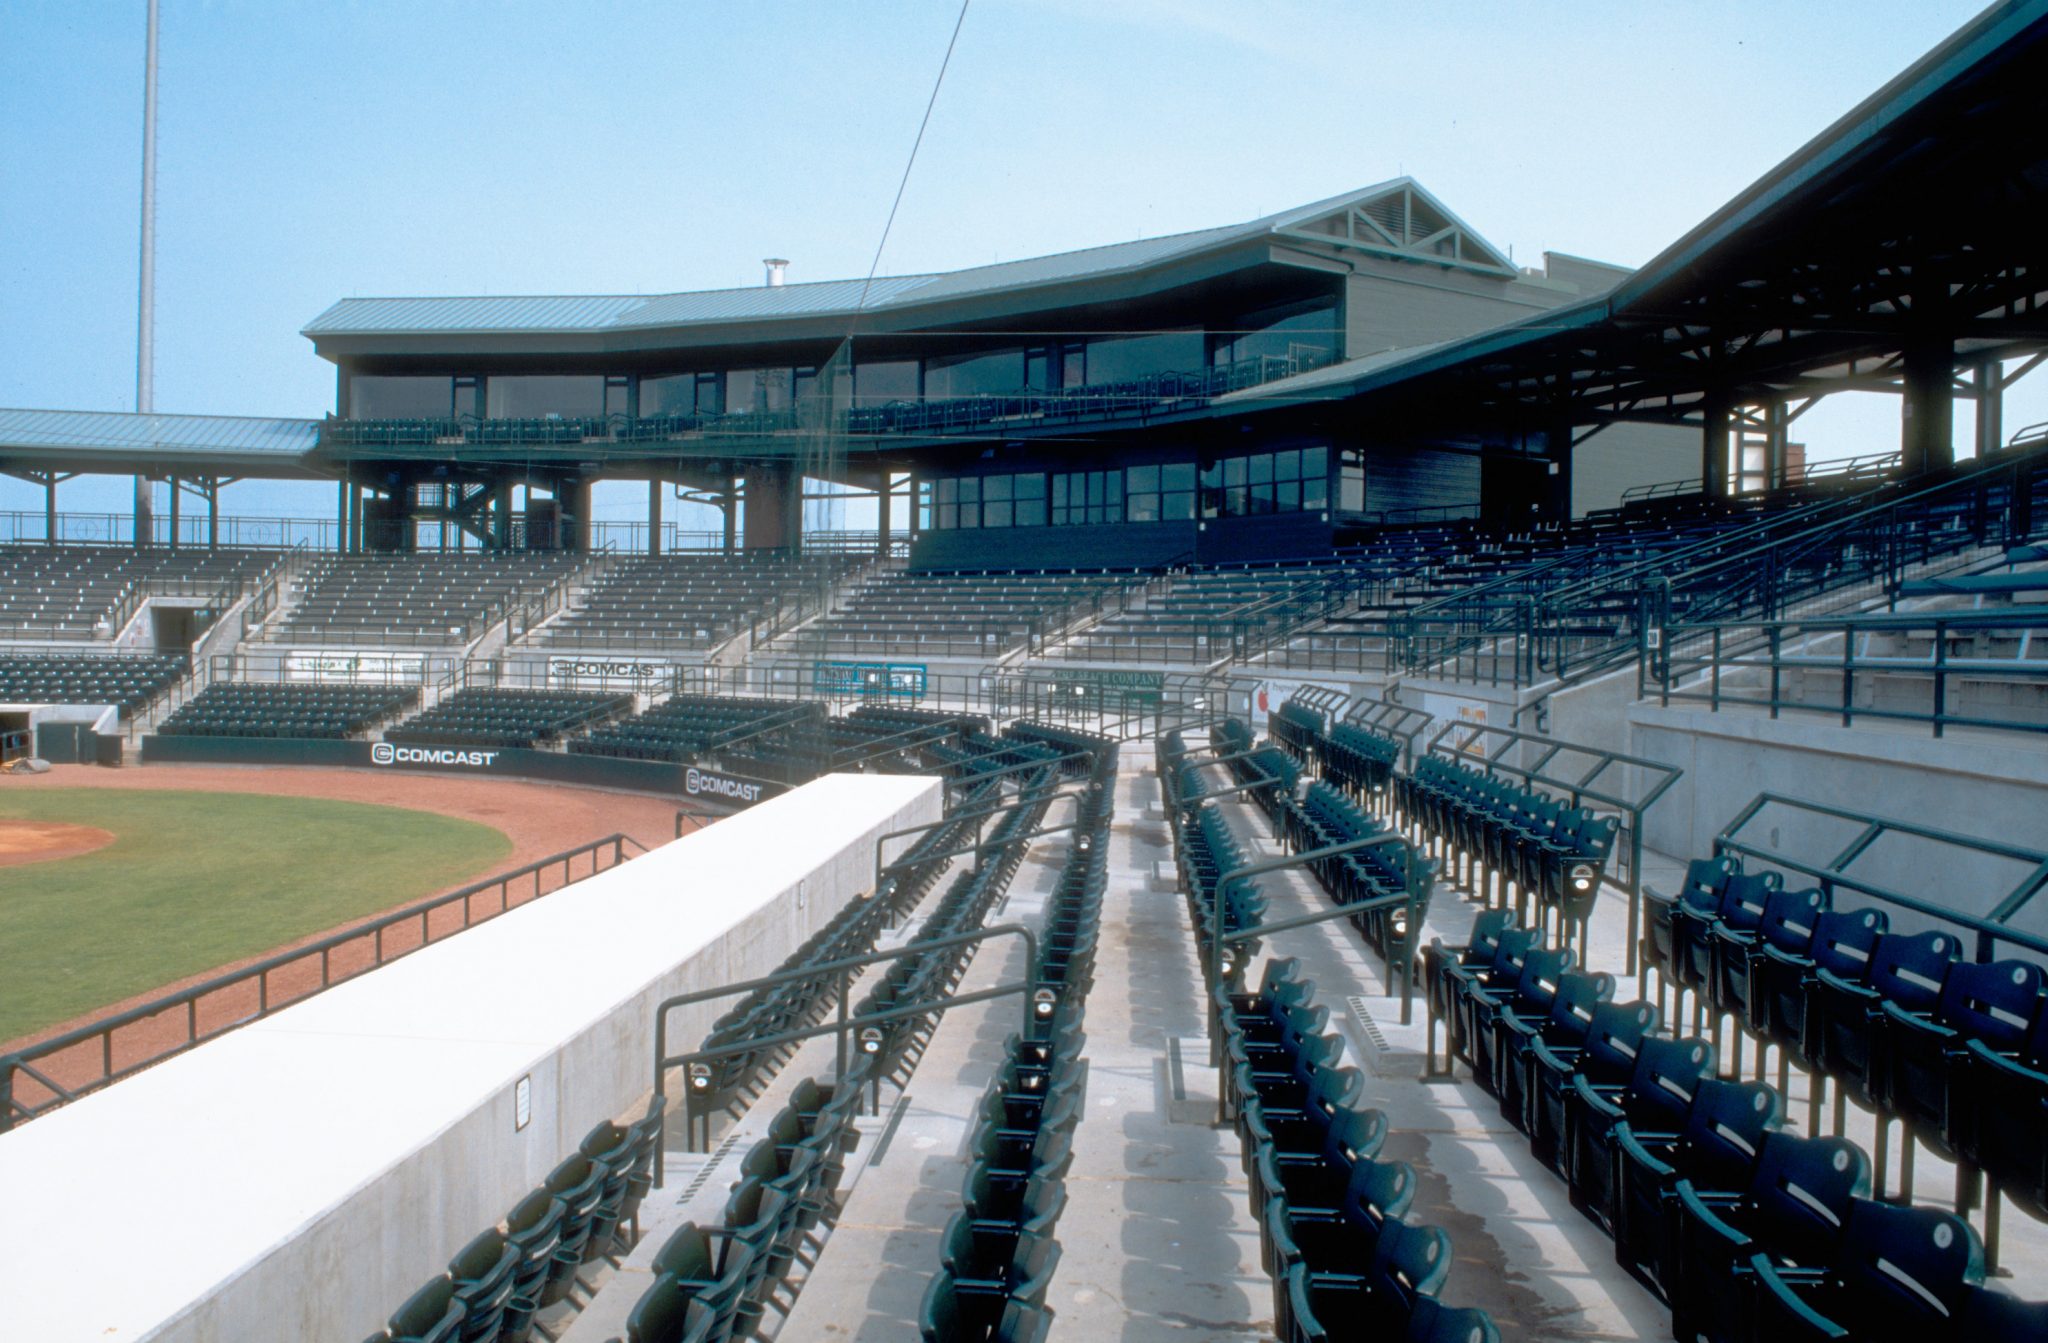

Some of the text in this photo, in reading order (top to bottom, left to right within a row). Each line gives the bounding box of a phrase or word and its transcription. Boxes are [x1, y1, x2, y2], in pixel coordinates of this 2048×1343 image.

[1112, 672, 1161, 685] COMPANY
[396, 748, 495, 765] COMCAST
[700, 775, 761, 801] COMCAST
